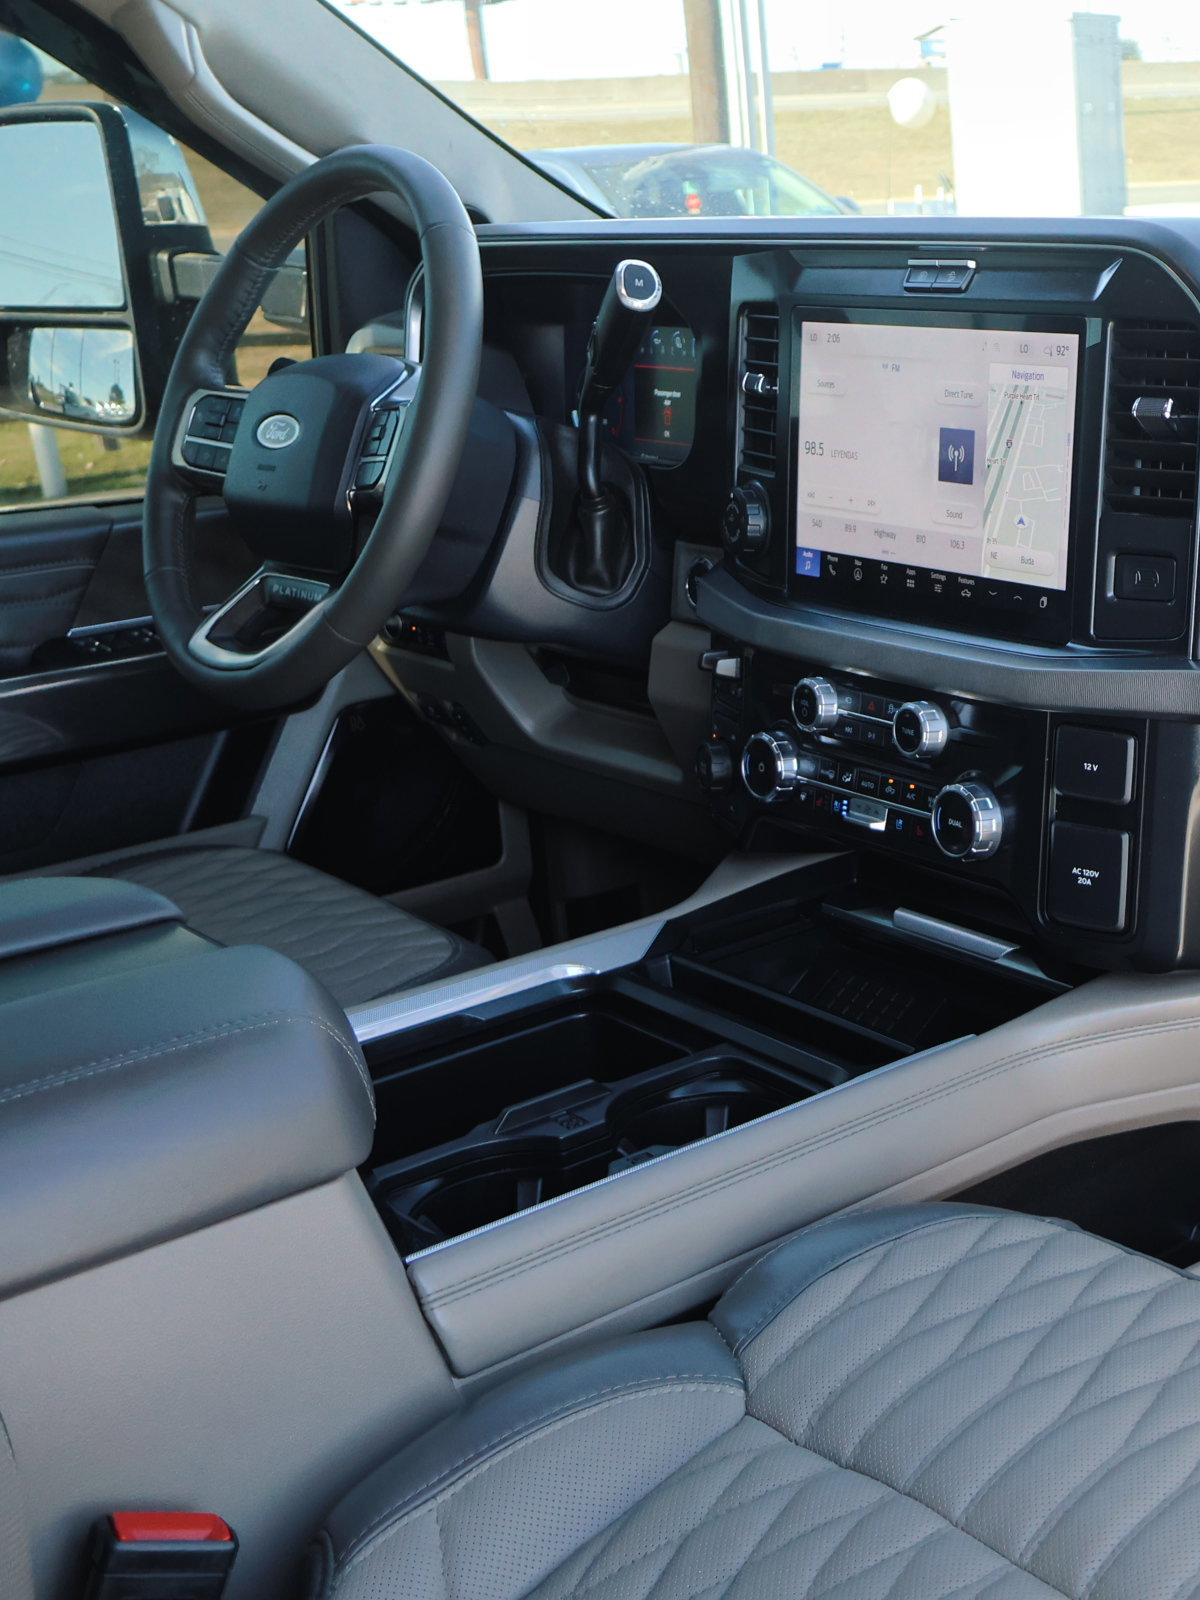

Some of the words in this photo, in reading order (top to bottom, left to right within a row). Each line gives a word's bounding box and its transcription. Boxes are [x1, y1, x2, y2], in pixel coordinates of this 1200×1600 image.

[634, 278, 644, 287] M
[827, 333, 841, 344] 2:06
[1011, 370, 1045, 381] Navigation
[804, 440, 825, 457] 98.5
[945, 509, 963, 520] Sound
[272, 583, 323, 602] PLATINUM
[1083, 762, 1092, 771] 12
[1071, 866, 1082, 876] AC
[1082, 869, 1100, 878] 120V
[1077, 876, 1092, 886] 20A
